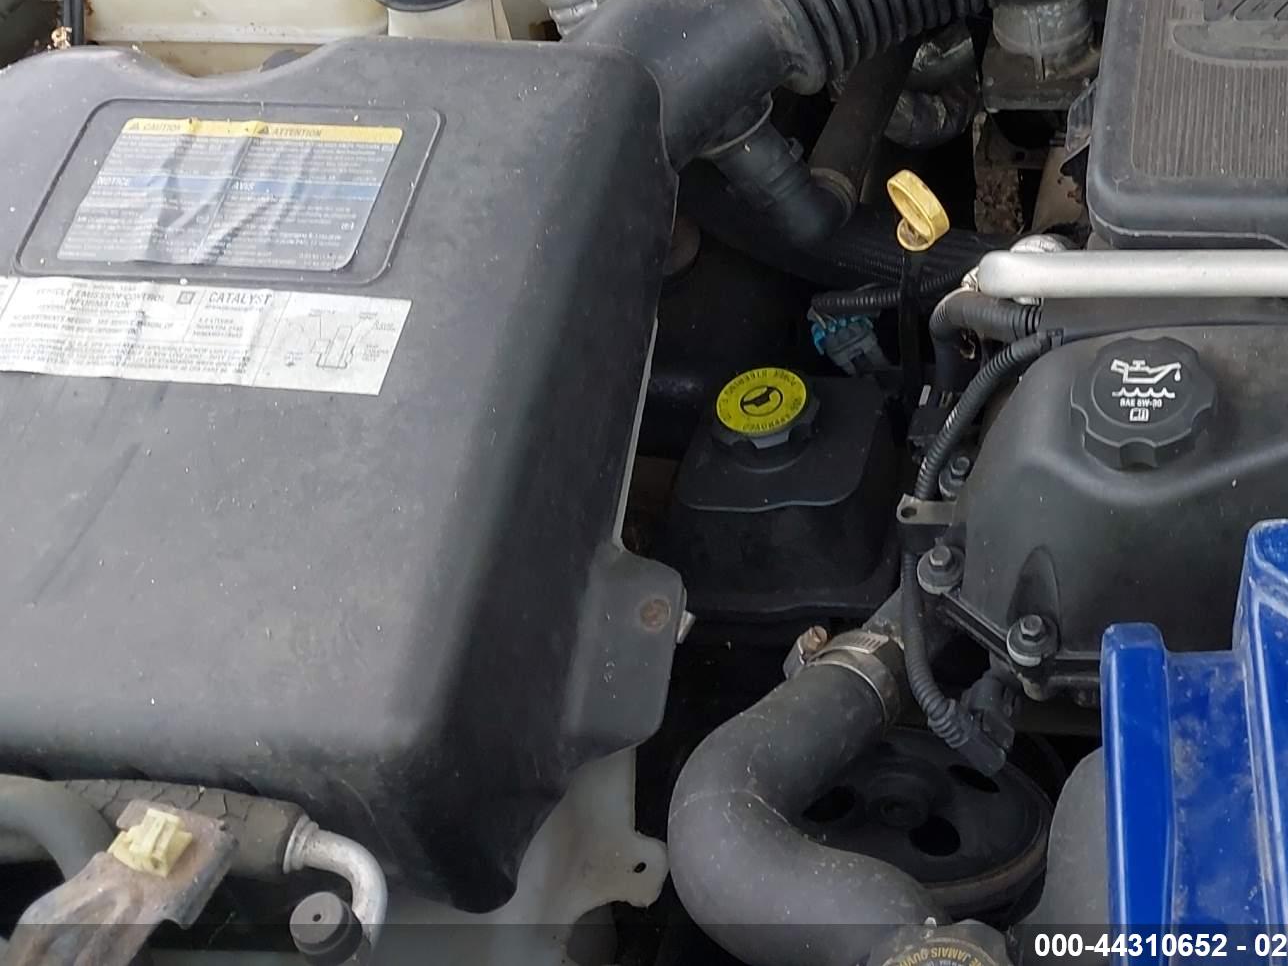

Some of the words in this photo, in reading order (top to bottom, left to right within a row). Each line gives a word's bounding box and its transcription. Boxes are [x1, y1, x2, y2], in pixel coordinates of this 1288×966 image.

[273, 128, 322, 137] ATTENTION
[96, 177, 130, 187] NOTICE
[232, 182, 255, 191] AVIS
[208, 292, 272, 306] CATALYST
[930, 947, 971, 962] JAMAIS
